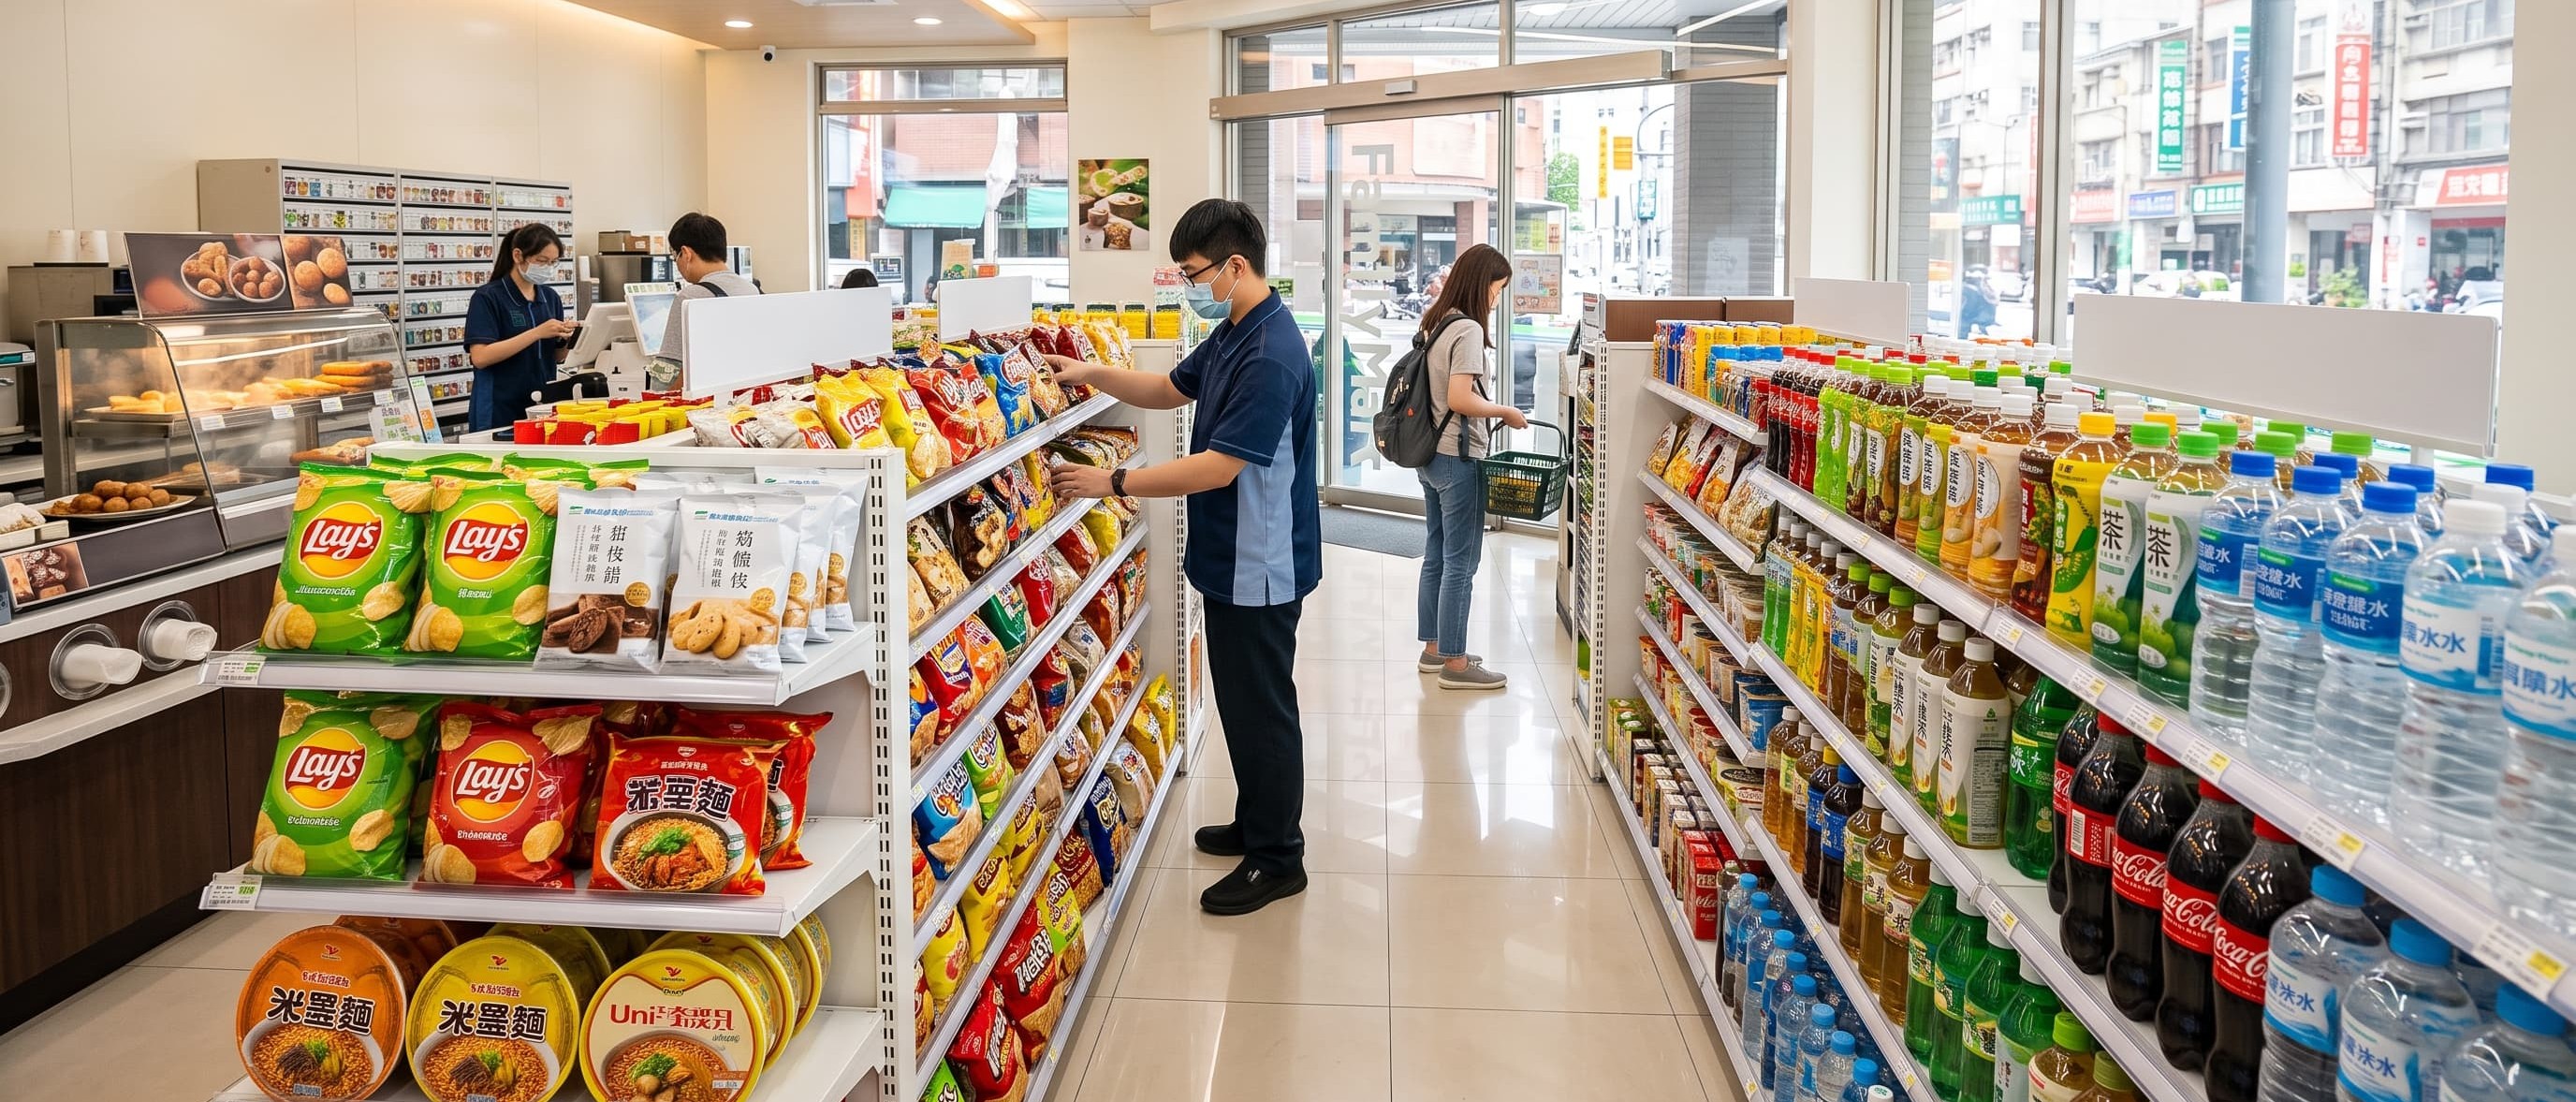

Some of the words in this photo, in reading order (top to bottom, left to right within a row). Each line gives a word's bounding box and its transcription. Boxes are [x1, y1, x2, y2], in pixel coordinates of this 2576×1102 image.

[304, 520, 379, 560] Lay's
[446, 521, 524, 562] Lay's
[2102, 509, 2124, 550] 茶
[2147, 525, 2172, 567] 茶
[288, 748, 362, 790] Lay's
[456, 760, 530, 802] Lay's
